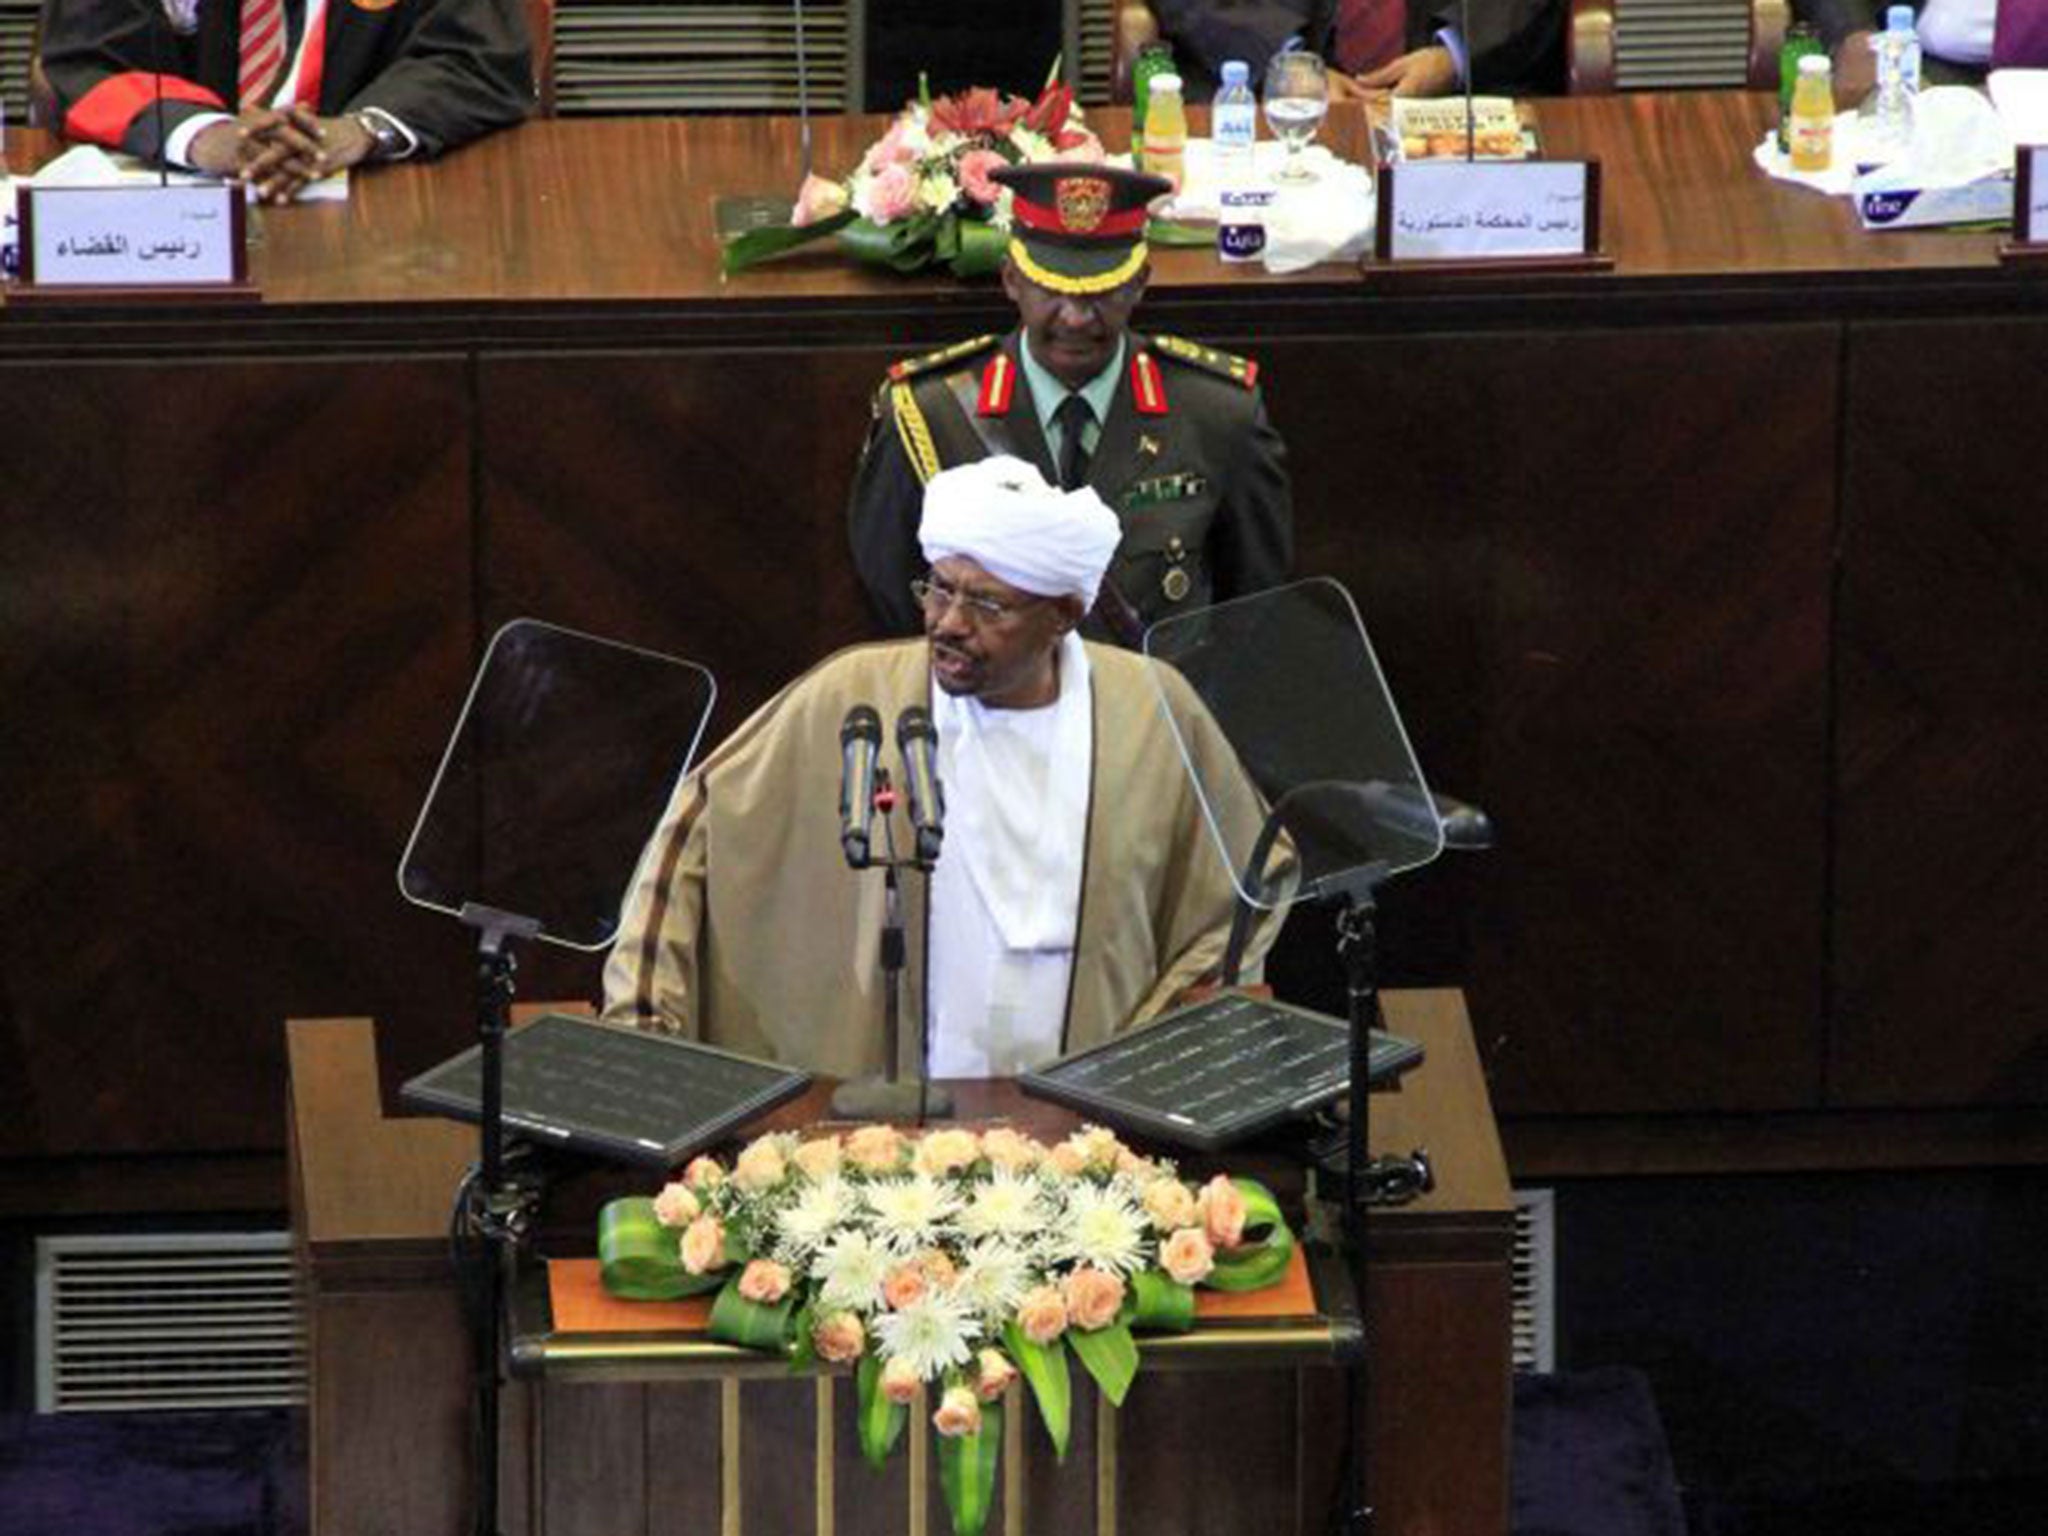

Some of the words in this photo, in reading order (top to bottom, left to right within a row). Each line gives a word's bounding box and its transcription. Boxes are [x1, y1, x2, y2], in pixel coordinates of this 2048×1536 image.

[1537, 213, 1580, 232] رئيس
[57, 233, 129, 256] القضاء
[138, 237, 200, 260] رئيس
